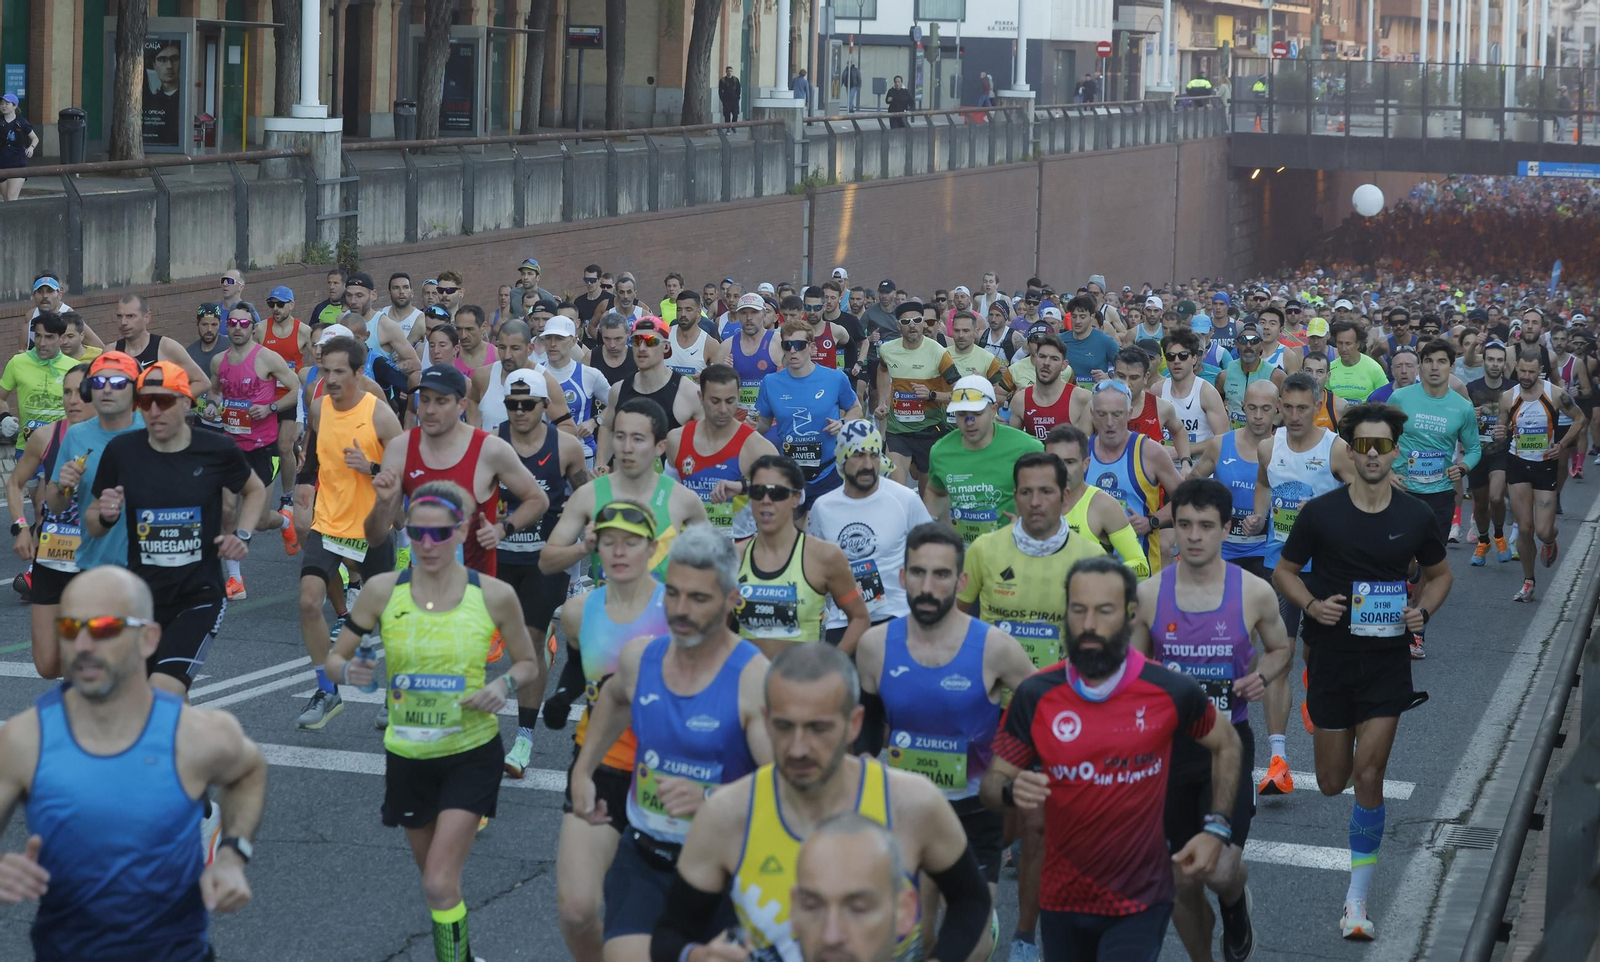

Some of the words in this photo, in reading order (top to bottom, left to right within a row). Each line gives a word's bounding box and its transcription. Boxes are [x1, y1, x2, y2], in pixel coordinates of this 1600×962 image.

[1414, 423, 1446, 433] CASCAIS
[958, 482, 994, 492] marcha
[158, 511, 194, 521] ZURICH
[149, 529, 180, 538] 4128
[138, 538, 202, 553] TUREGANO
[47, 548, 75, 560] MART
[1374, 584, 1403, 593] ZURICH
[1360, 612, 1400, 623] SOARES
[1163, 644, 1233, 657] TOULOUSE
[1185, 666, 1224, 676] ZURICH
[414, 678, 456, 688] ZURICH
[405, 711, 448, 725] MILLIE
[915, 737, 958, 750] ZURICH
[663, 760, 712, 780] ZURICH
